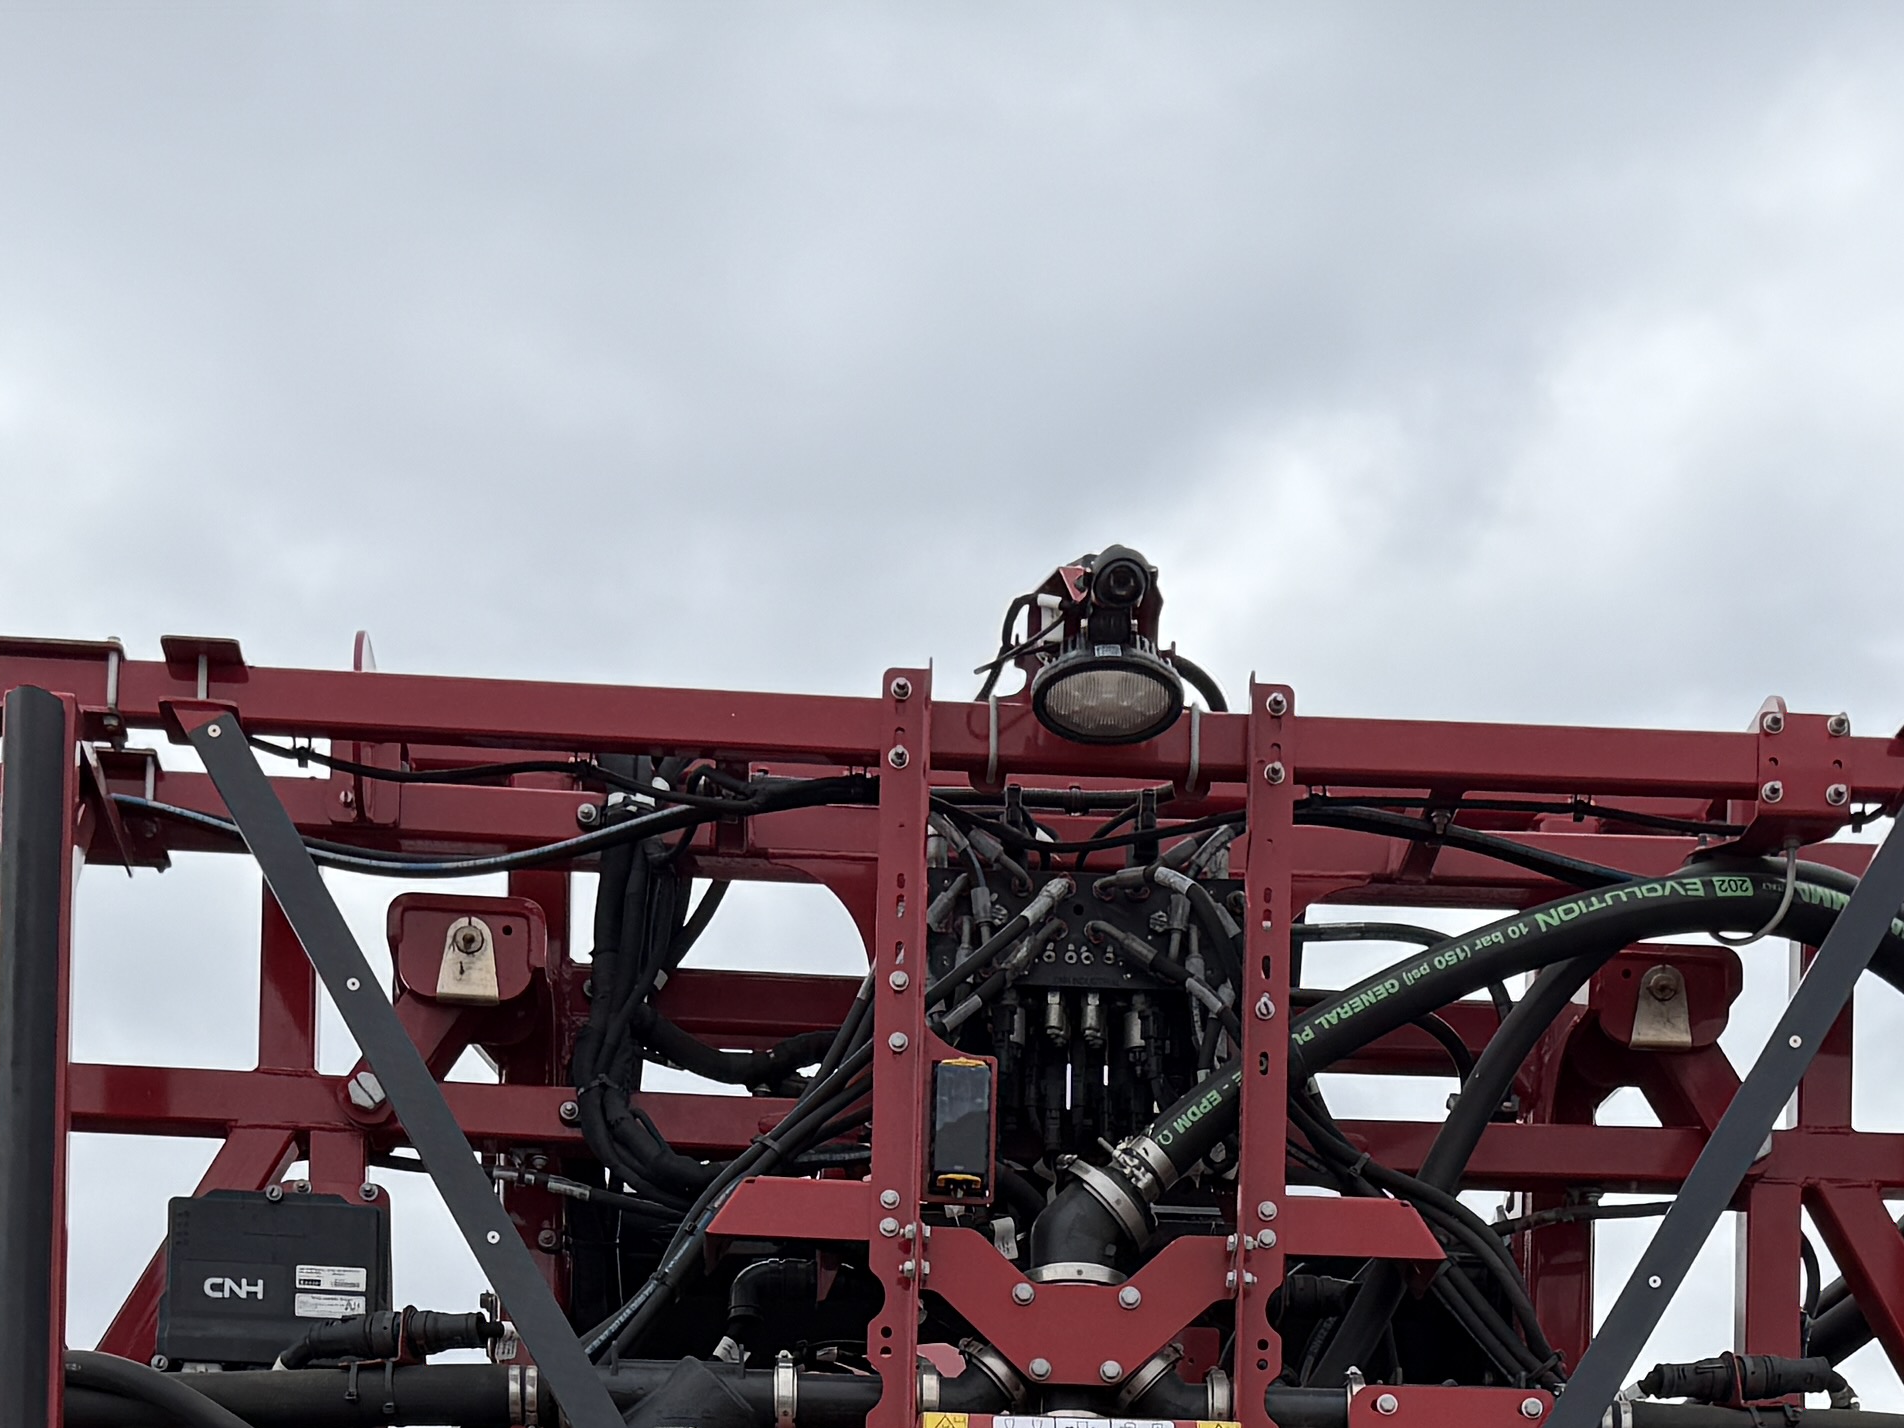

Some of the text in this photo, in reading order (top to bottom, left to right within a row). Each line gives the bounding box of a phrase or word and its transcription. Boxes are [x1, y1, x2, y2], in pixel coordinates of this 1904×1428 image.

[1718, 878, 1751, 894] 202
[1534, 878, 1705, 932] EVOLUTION
[1475, 931, 1505, 951] bar
[1507, 922, 1530, 940] 10
[1433, 943, 1472, 970] (150
[1314, 979, 1400, 1030] GENERAL
[1173, 1089, 1222, 1134] EPDM
[203, 1277, 264, 1300] CNH
